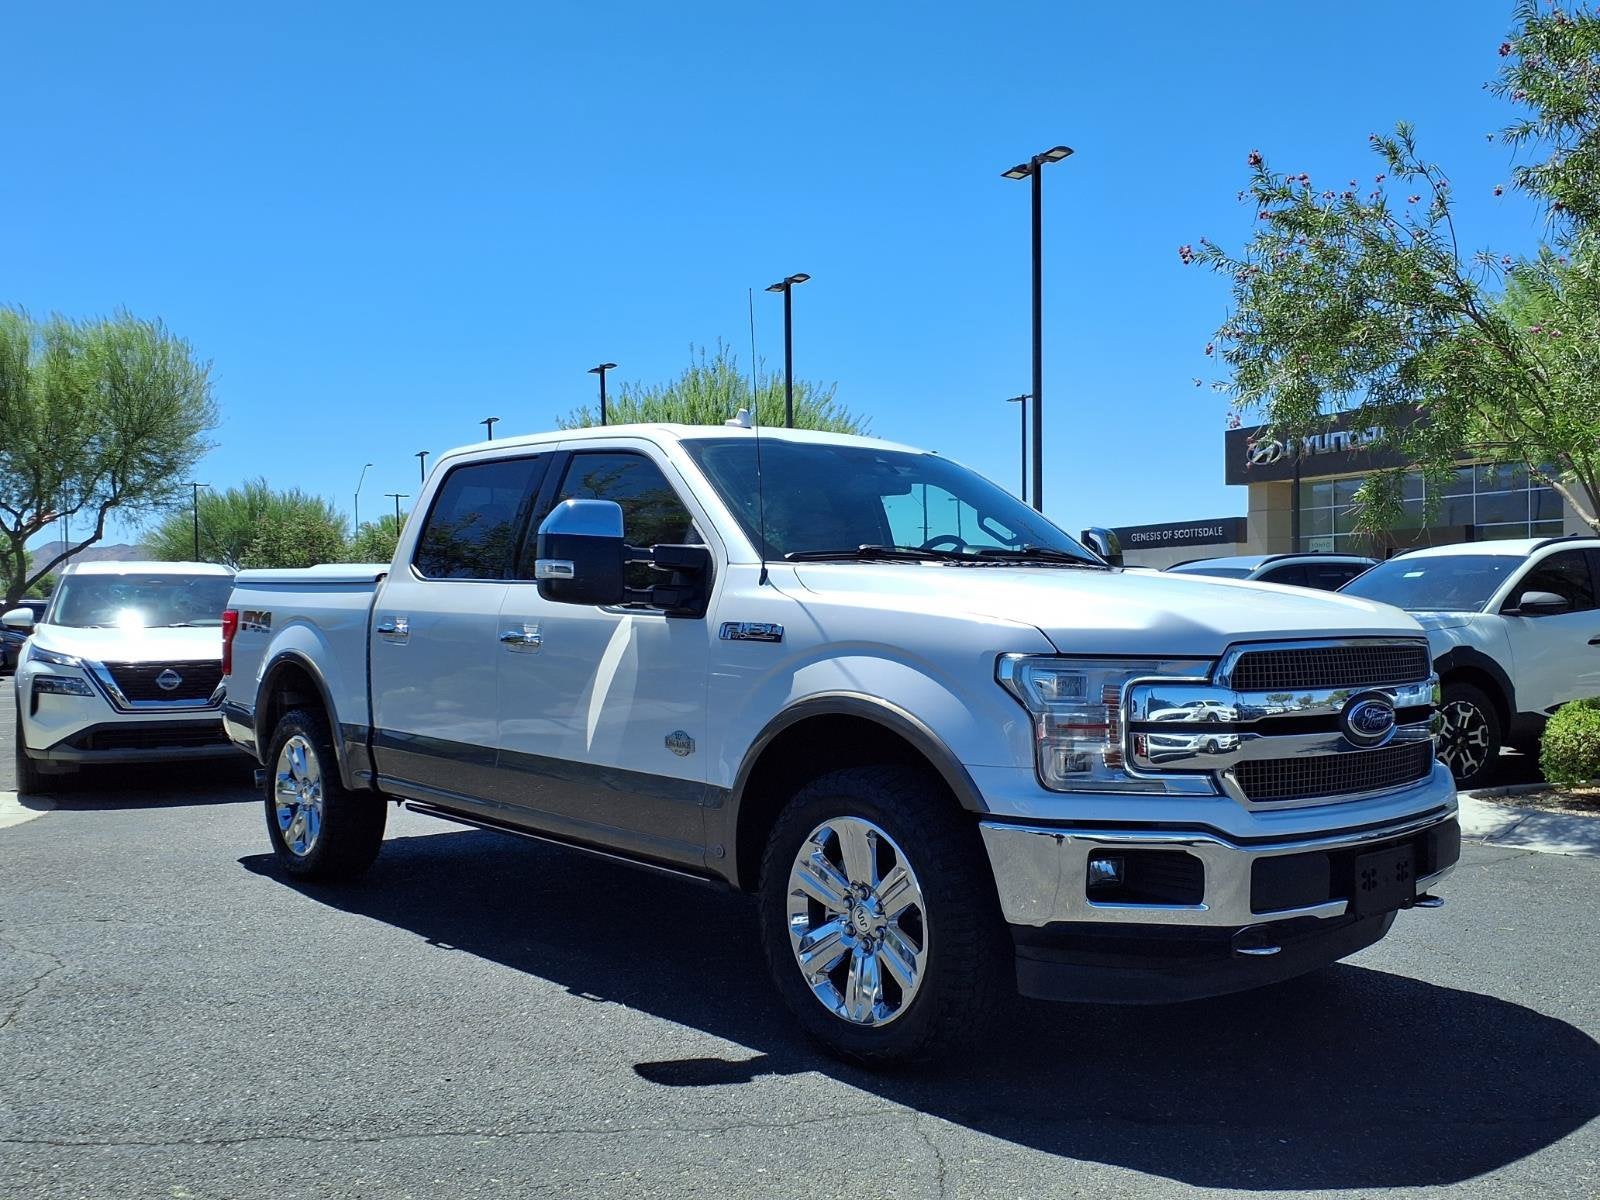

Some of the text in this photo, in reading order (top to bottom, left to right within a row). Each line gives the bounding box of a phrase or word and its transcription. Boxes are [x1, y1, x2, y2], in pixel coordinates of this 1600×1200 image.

[1131, 526, 1223, 542] GENESIS OF SCOTTSDALE
[1362, 706, 1388, 729] Ford
